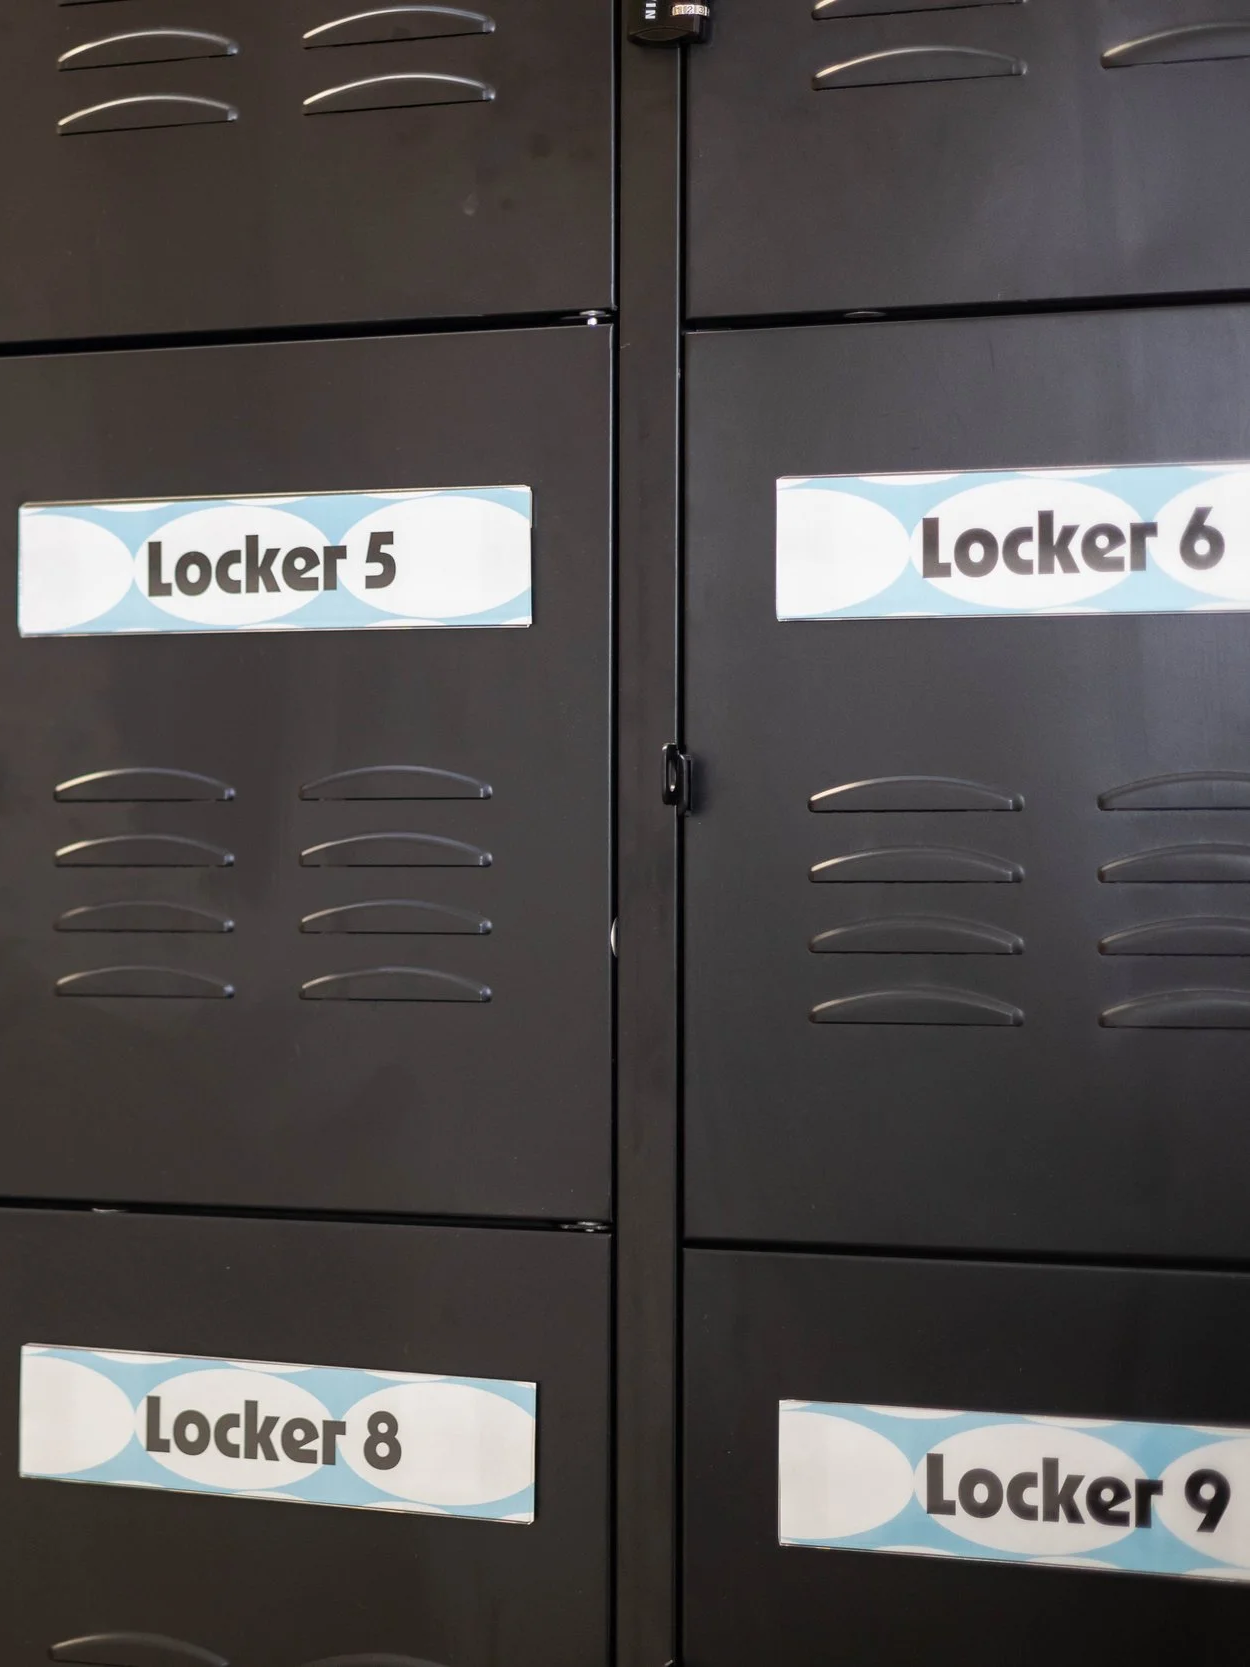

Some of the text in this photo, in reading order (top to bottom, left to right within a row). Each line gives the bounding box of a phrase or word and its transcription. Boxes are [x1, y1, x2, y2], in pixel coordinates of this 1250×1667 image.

[149, 531, 395, 597] Locker 5
[922, 508, 1225, 578] Locker 6
[146, 1396, 402, 1471] Locker 8
[926, 1453, 1231, 1533] Locker 9
